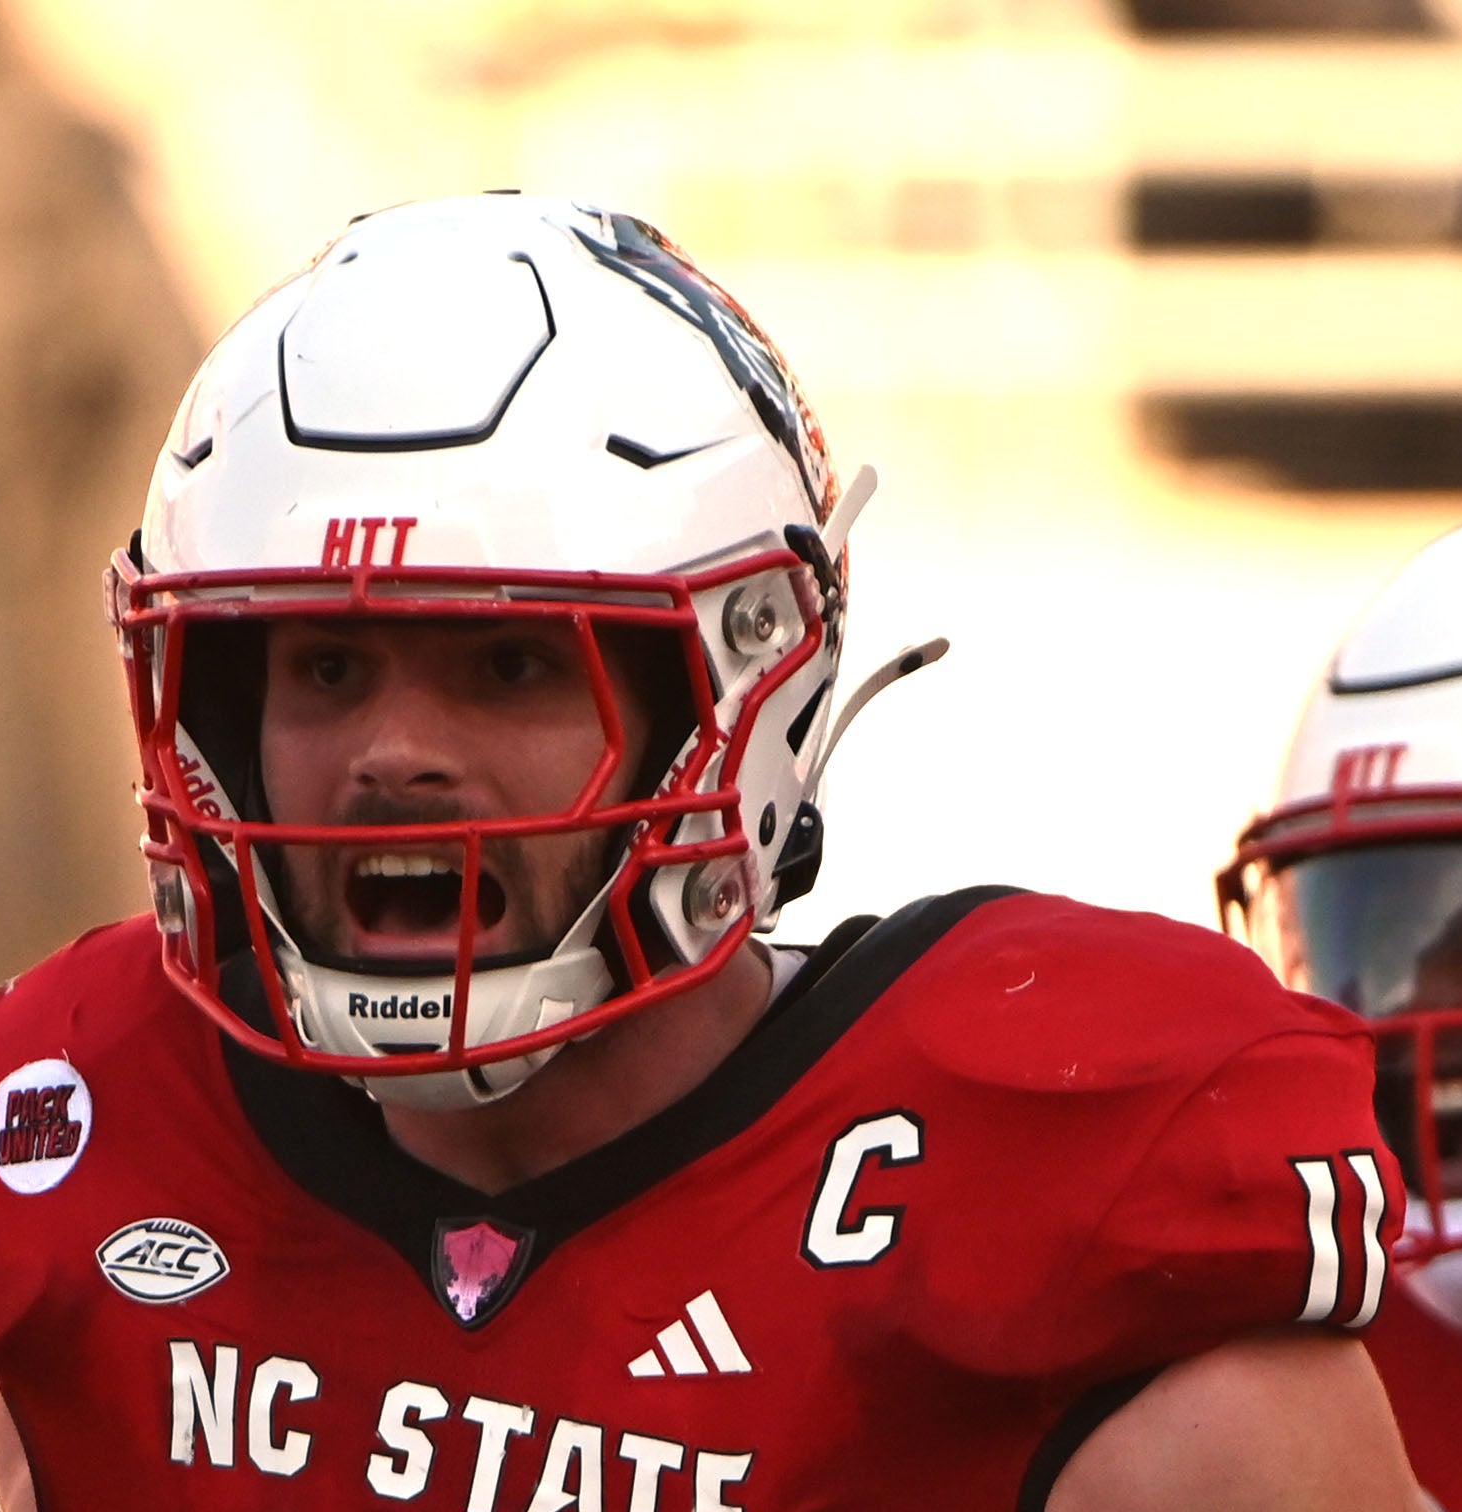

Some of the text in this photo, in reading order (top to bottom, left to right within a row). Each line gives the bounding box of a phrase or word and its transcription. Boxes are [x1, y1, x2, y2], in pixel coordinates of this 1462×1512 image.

[322, 516, 418, 568] HTT
[6, 1084, 76, 1128] PACK
[801, 1108, 924, 1269] C
[114, 1238, 213, 1273] ACC
[1291, 1150, 1387, 1330] 11
[168, 1338, 322, 1478] NC
